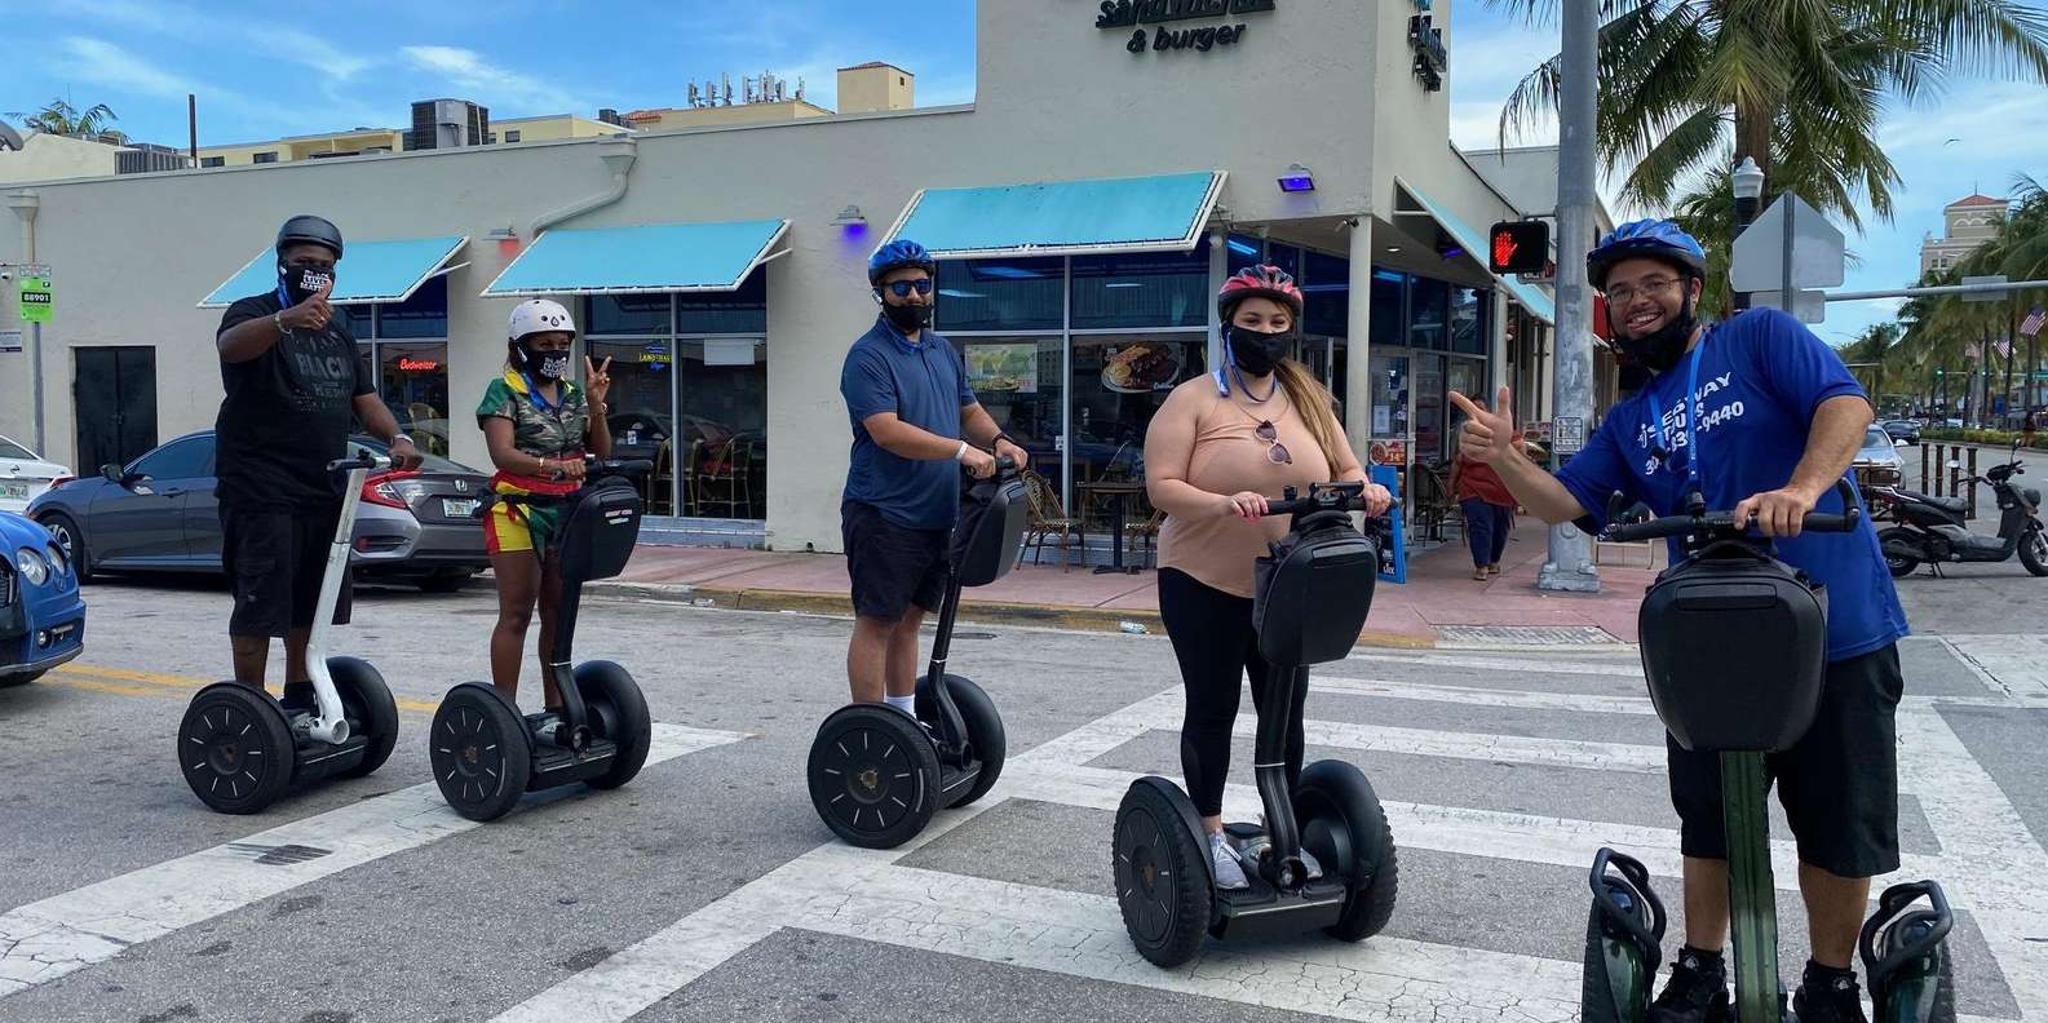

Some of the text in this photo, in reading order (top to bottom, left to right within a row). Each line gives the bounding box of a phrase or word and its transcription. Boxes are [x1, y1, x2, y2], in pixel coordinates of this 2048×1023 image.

[1127, 24, 1247, 53] & burger
[1663, 402, 1704, 441] TUS
